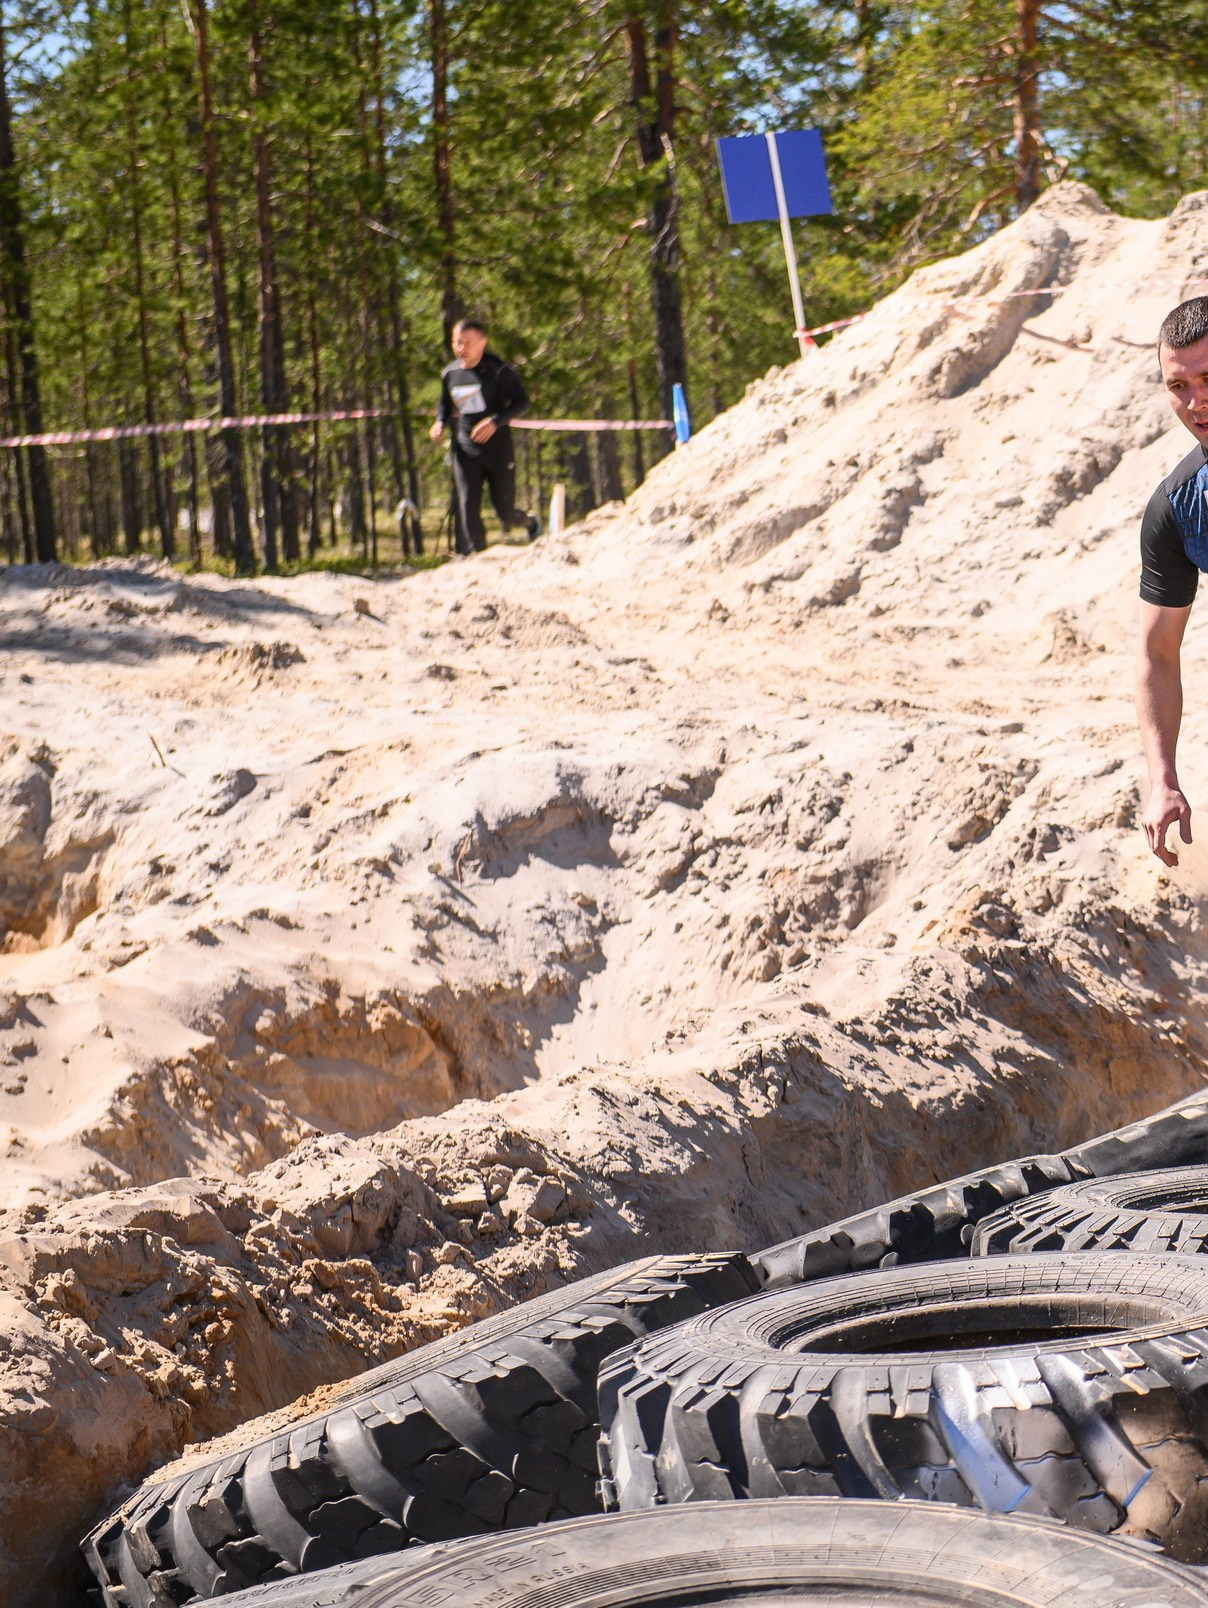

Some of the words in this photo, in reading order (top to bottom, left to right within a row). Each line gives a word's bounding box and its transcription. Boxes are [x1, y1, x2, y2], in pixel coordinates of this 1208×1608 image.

[472, 1587, 514, 1608] MADE
[514, 1581, 531, 1592] IN
[531, 1562, 591, 1583] RUSSIA
